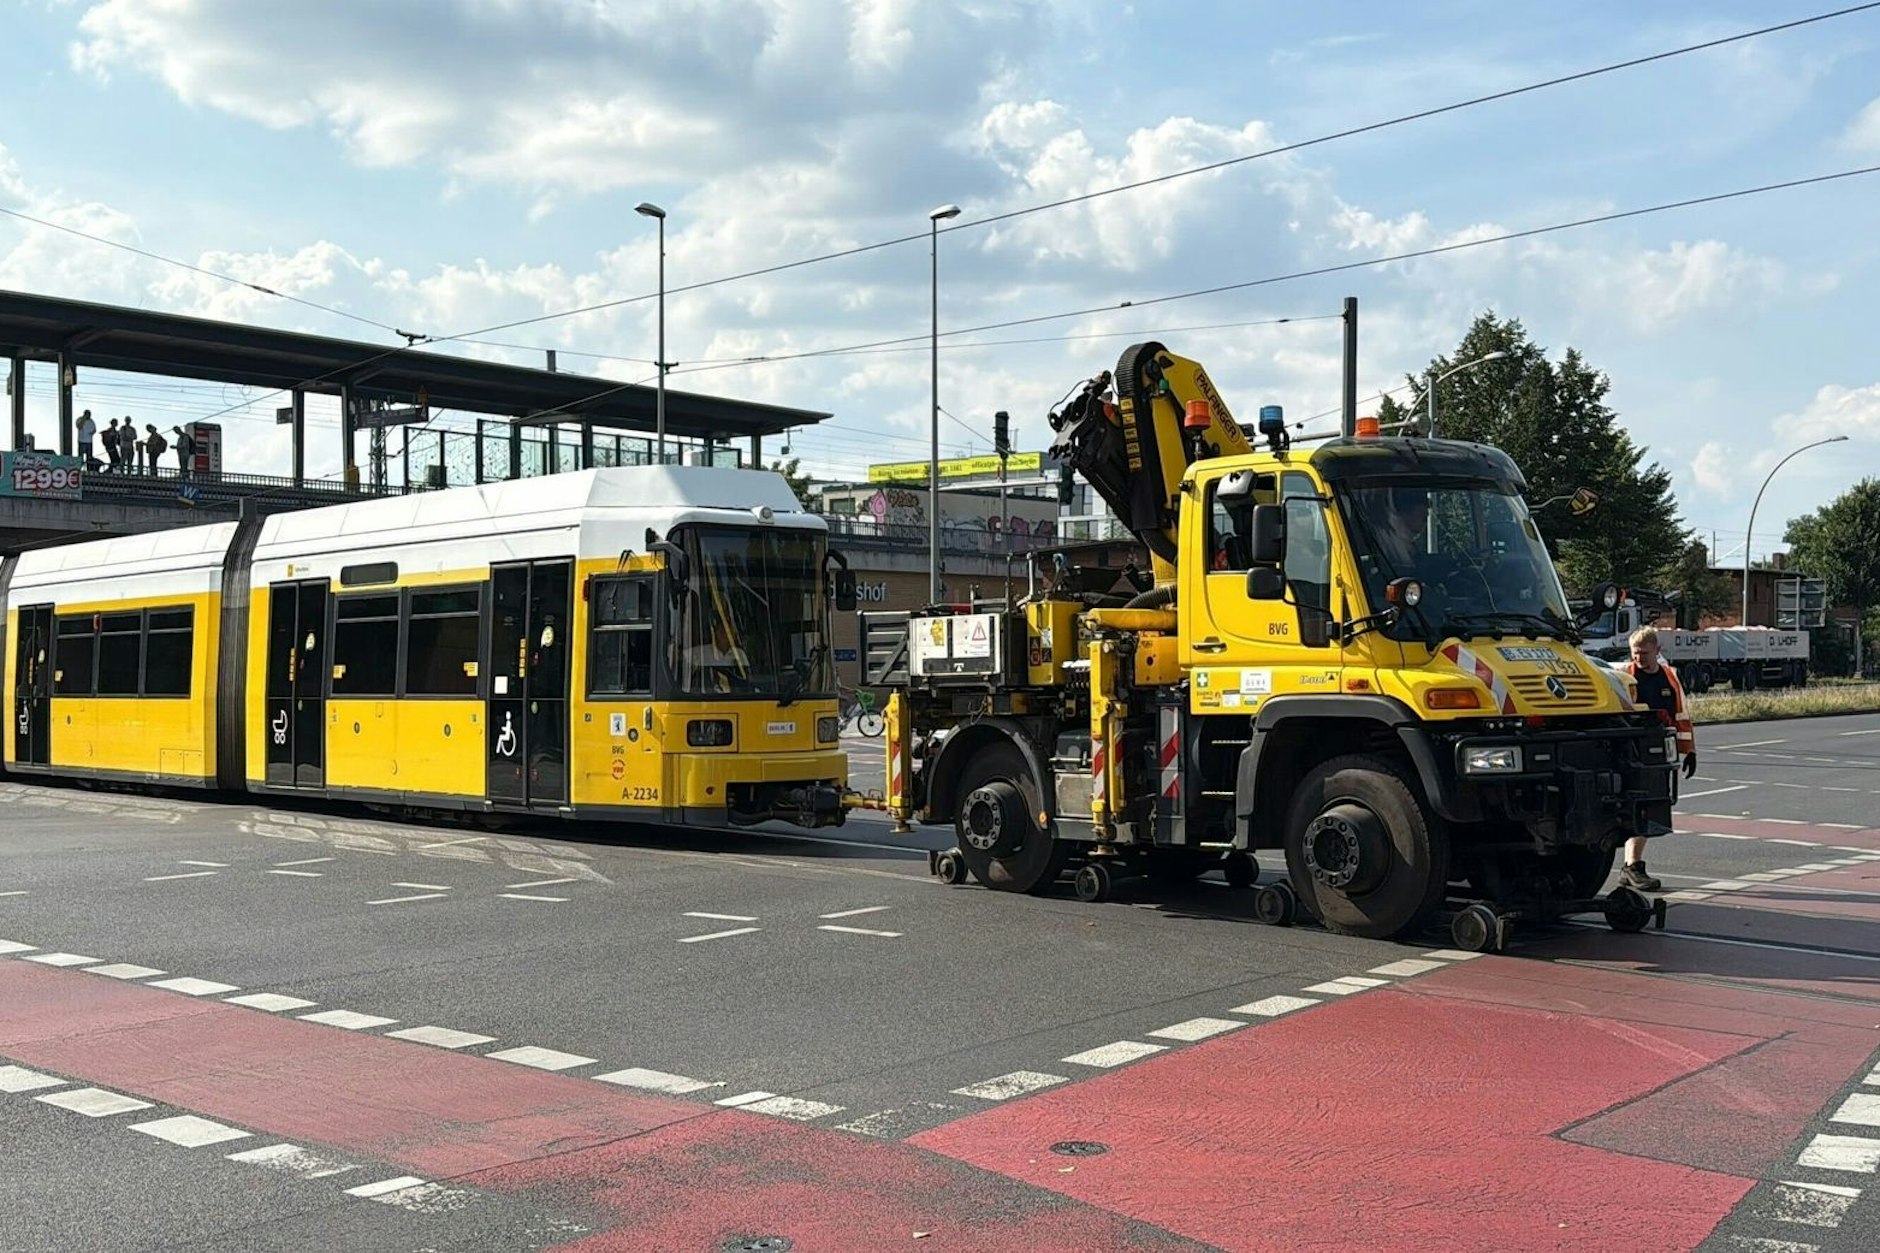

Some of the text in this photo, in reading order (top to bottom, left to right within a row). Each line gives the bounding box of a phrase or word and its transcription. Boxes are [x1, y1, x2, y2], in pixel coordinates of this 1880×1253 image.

[12, 467, 80, 491] 1299€
[1269, 623, 1288, 635] BVG
[612, 746, 625, 755] BVG
[621, 786, 659, 801] A-2234
